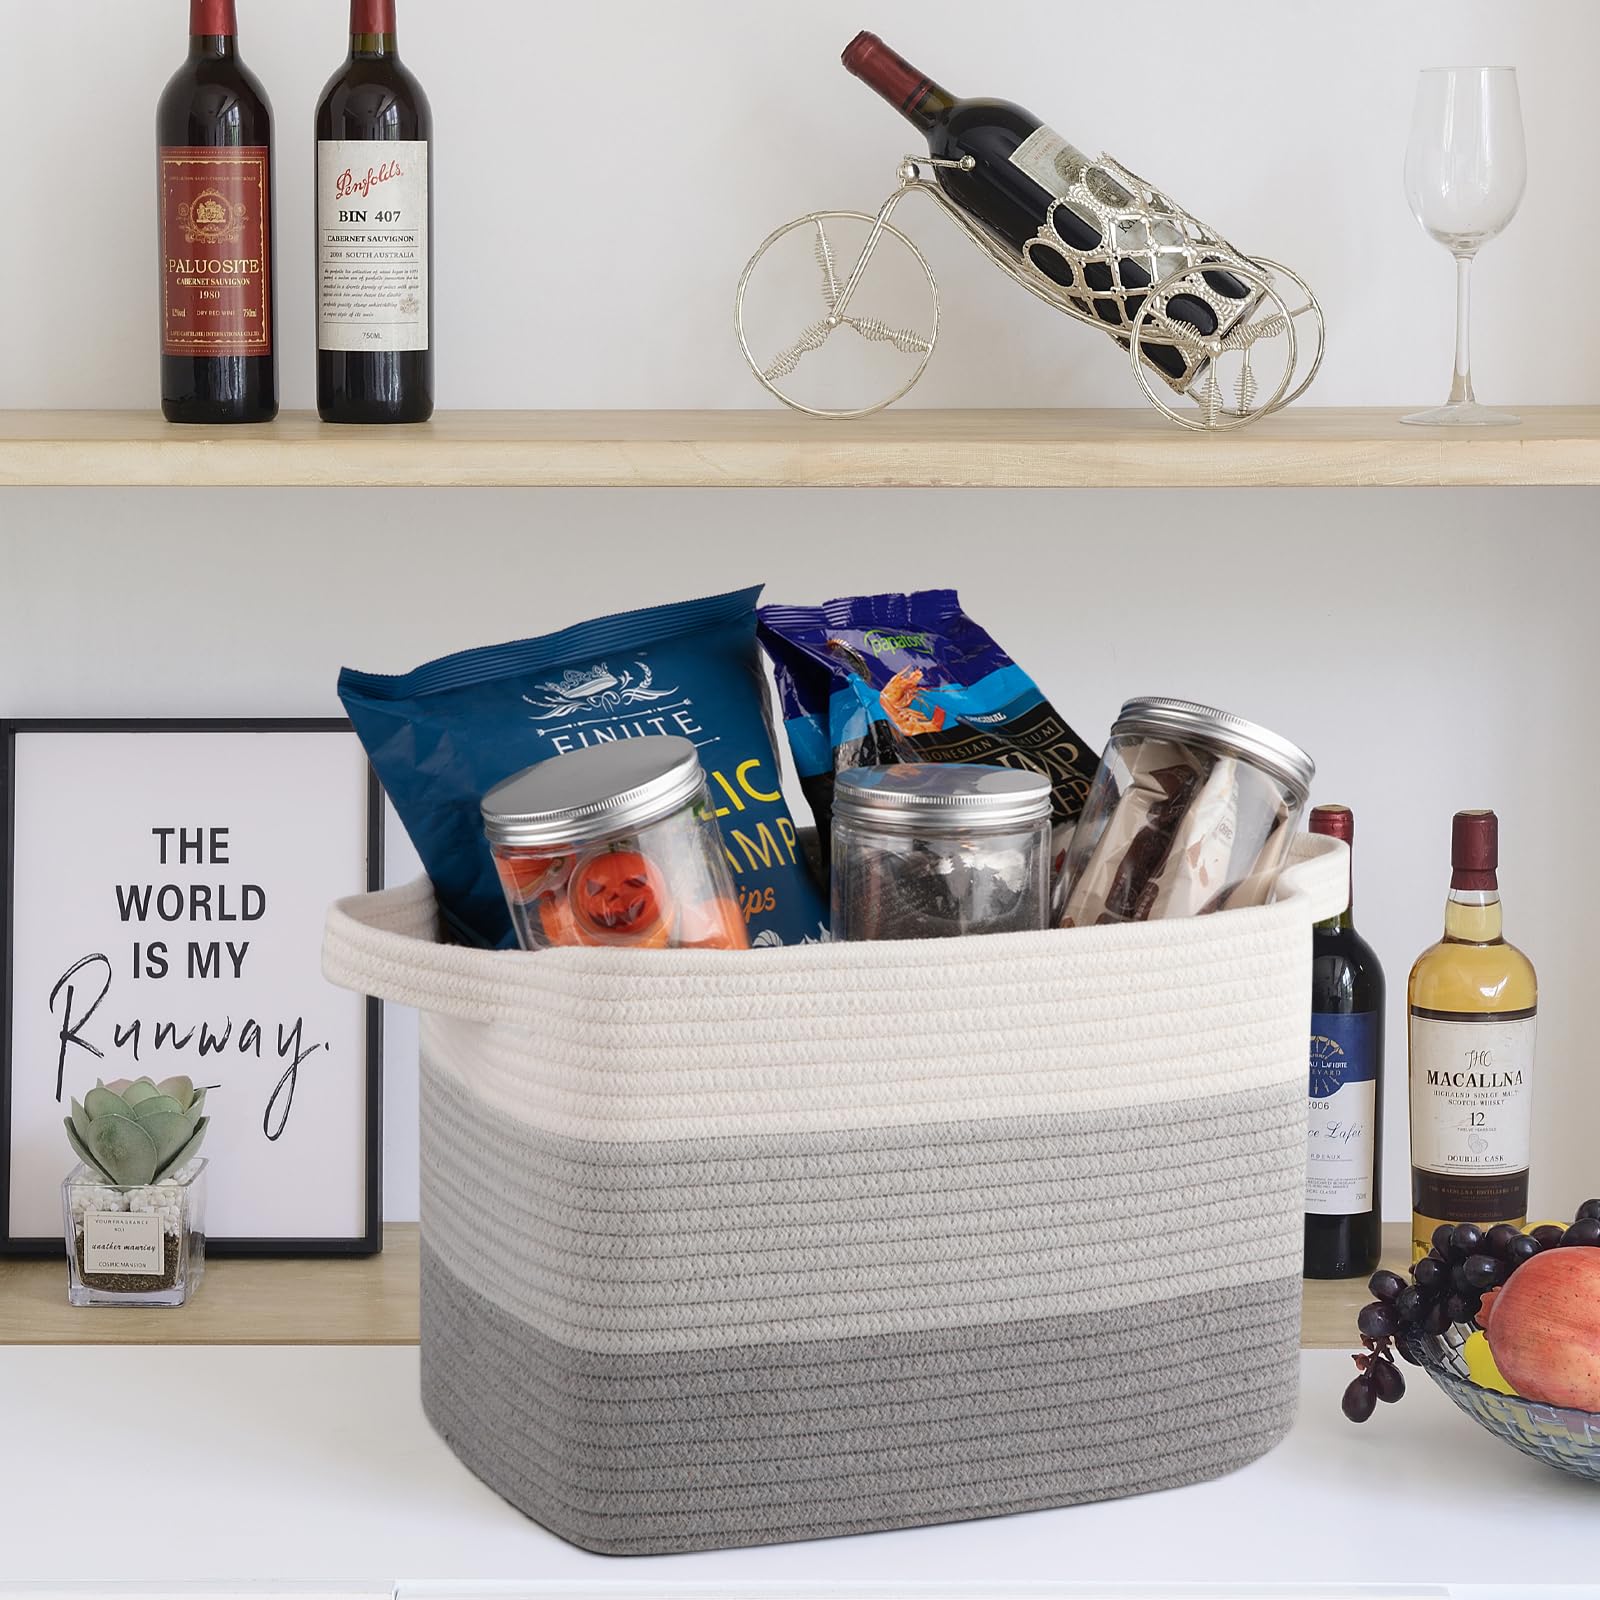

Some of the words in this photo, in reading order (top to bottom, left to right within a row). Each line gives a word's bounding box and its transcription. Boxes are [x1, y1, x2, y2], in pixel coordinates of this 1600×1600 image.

[339, 210, 368, 222] BIN
[374, 210, 401, 222] 407
[327, 235, 366, 243] CABERNET
[367, 235, 414, 243] SAUVIGNON
[169, 259, 260, 274] PALUOSITE
[176, 278, 210, 286] CABERNET
[210, 278, 251, 286] SAUVIGNON
[199, 290, 221, 300] 1980
[152, 827, 230, 864] THE
[115, 884, 267, 922] WORLD
[133, 941, 169, 979] IS
[187, 941, 250, 979] MY
[1427, 1069, 1523, 1088] MACALLNA
[1470, 1112, 1486, 1126] 12
